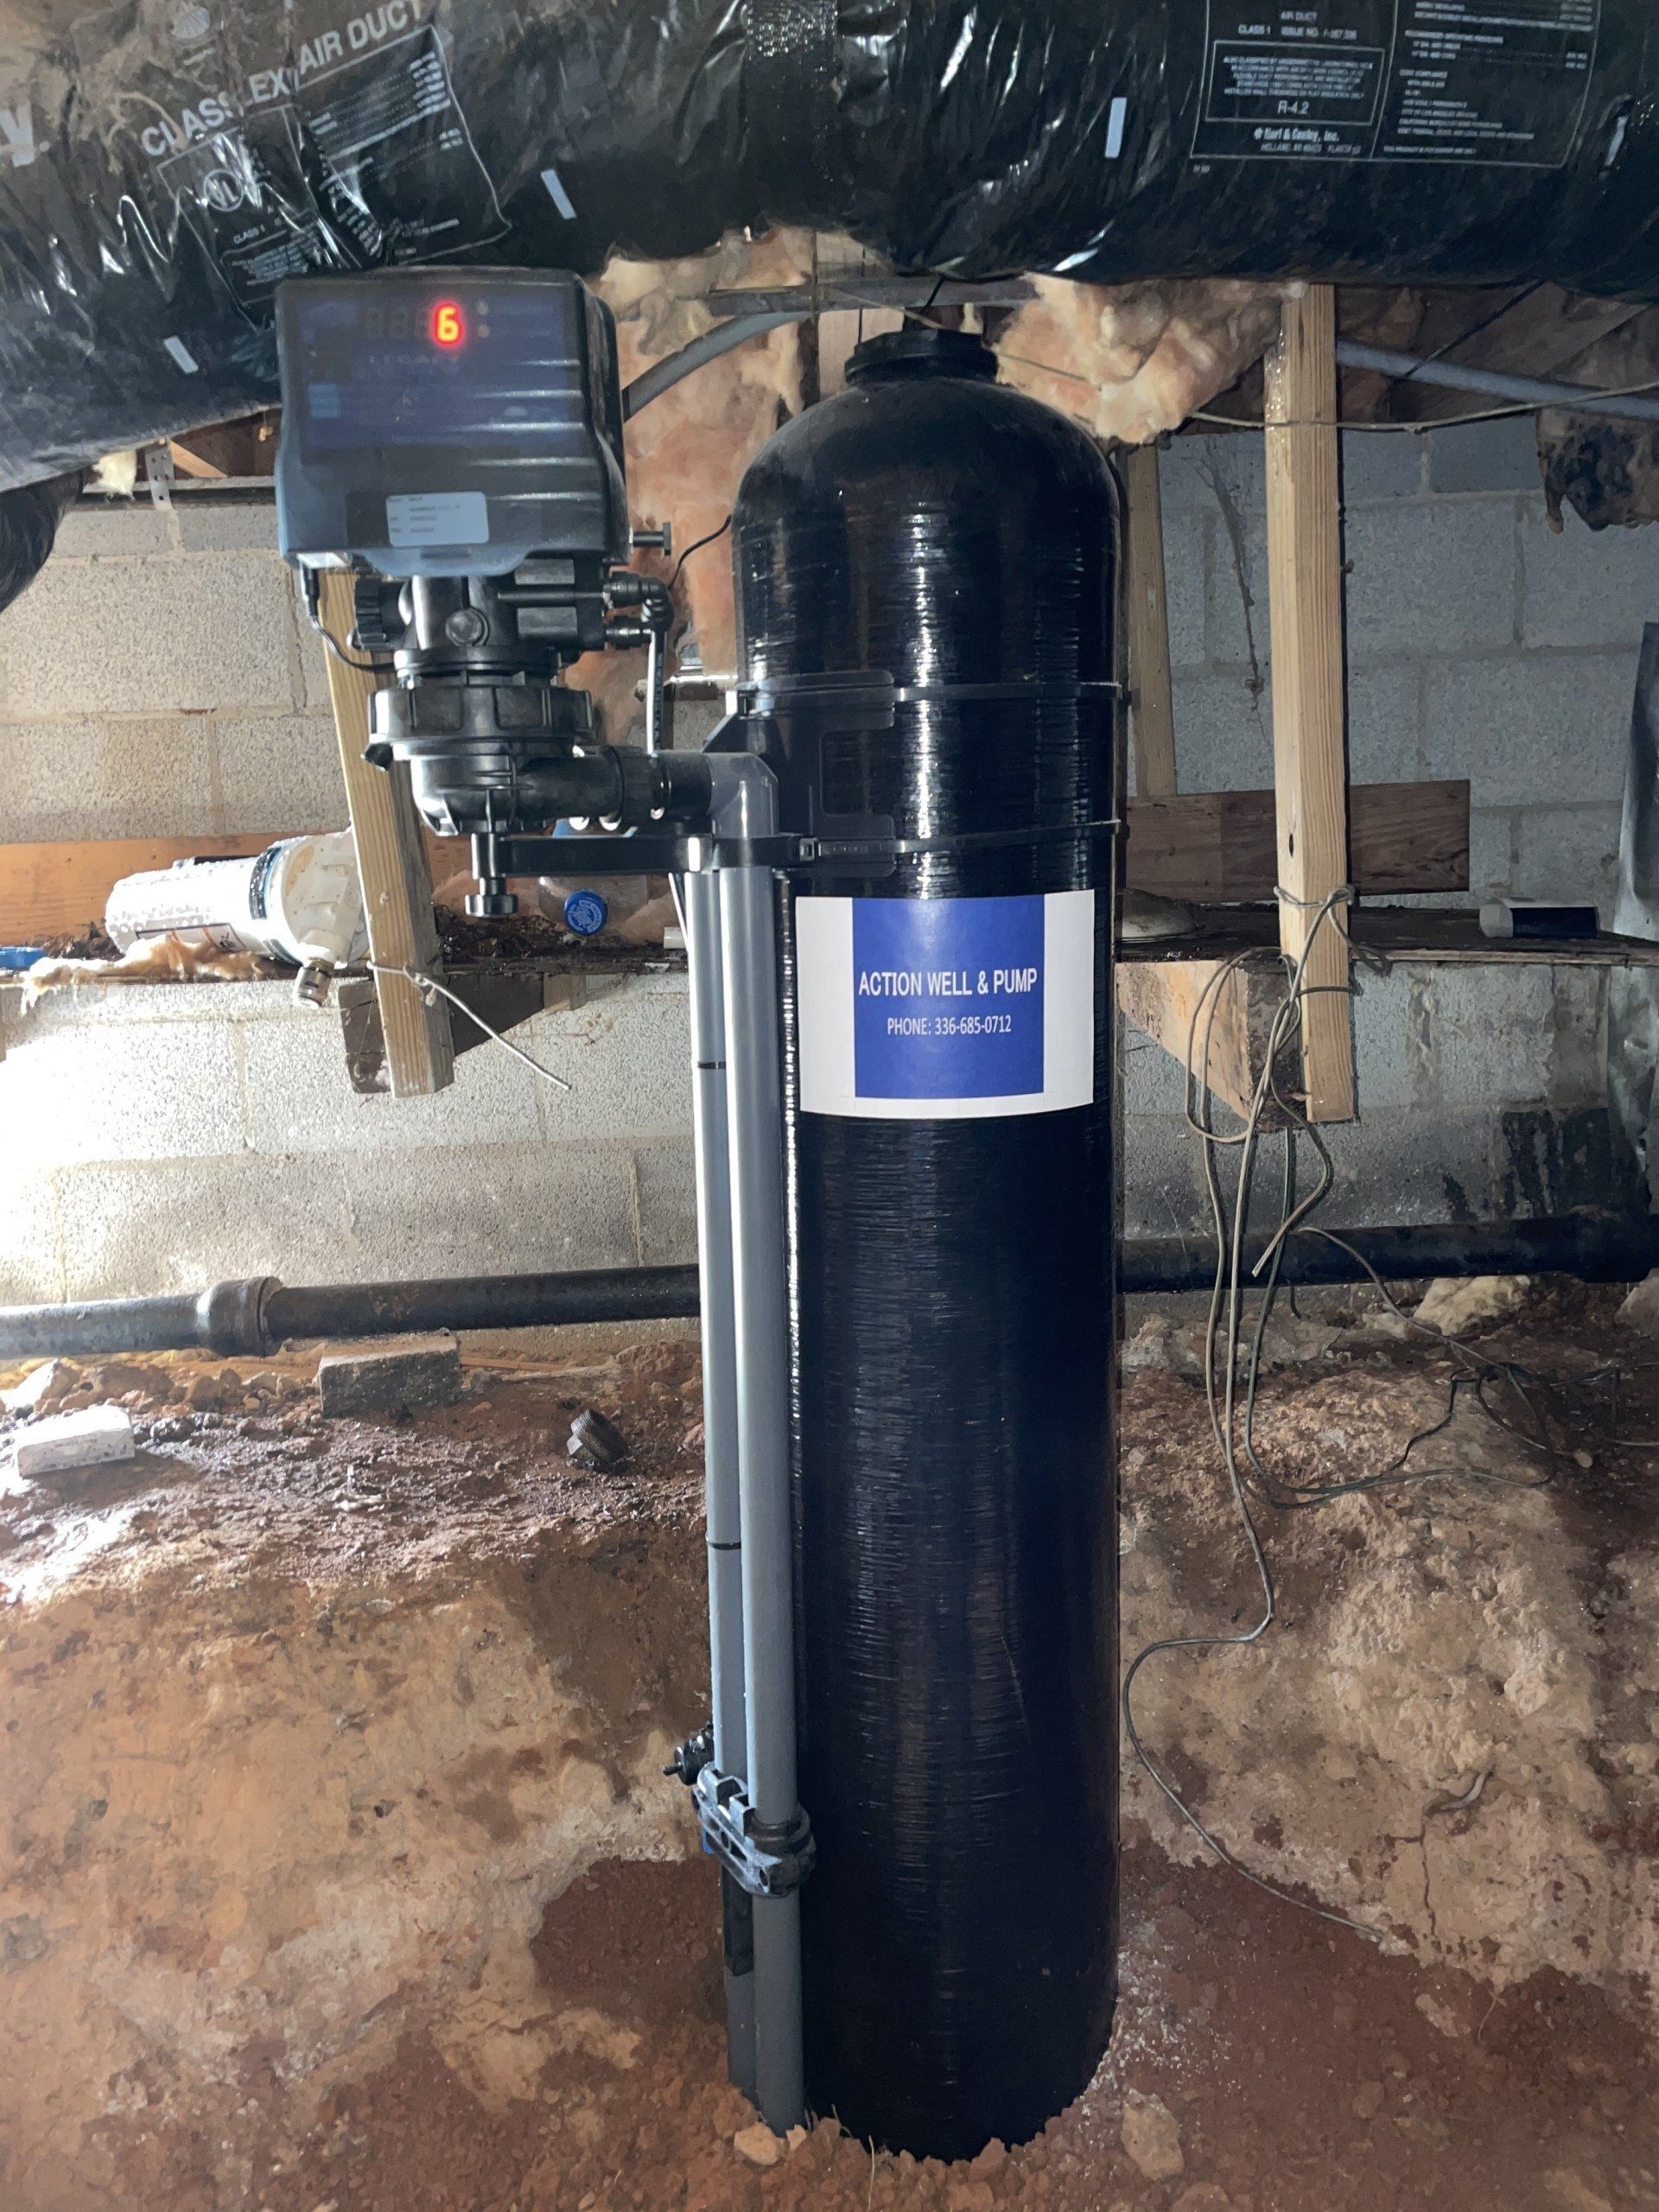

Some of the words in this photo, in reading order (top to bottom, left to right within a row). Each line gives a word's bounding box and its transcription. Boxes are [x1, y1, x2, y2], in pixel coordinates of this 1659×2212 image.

[299, 30, 343, 75] AIR
[1277, 100, 1310, 115] R-4.2
[435, 306, 461, 343] 6
[859, 971, 922, 996] ACTION
[927, 970, 973, 995] WELL
[977, 969, 988, 994] &
[994, 967, 1038, 993] PUMP
[887, 1018, 931, 1035] PHONE:
[935, 1014, 1012, 1035] 336-685-0712
